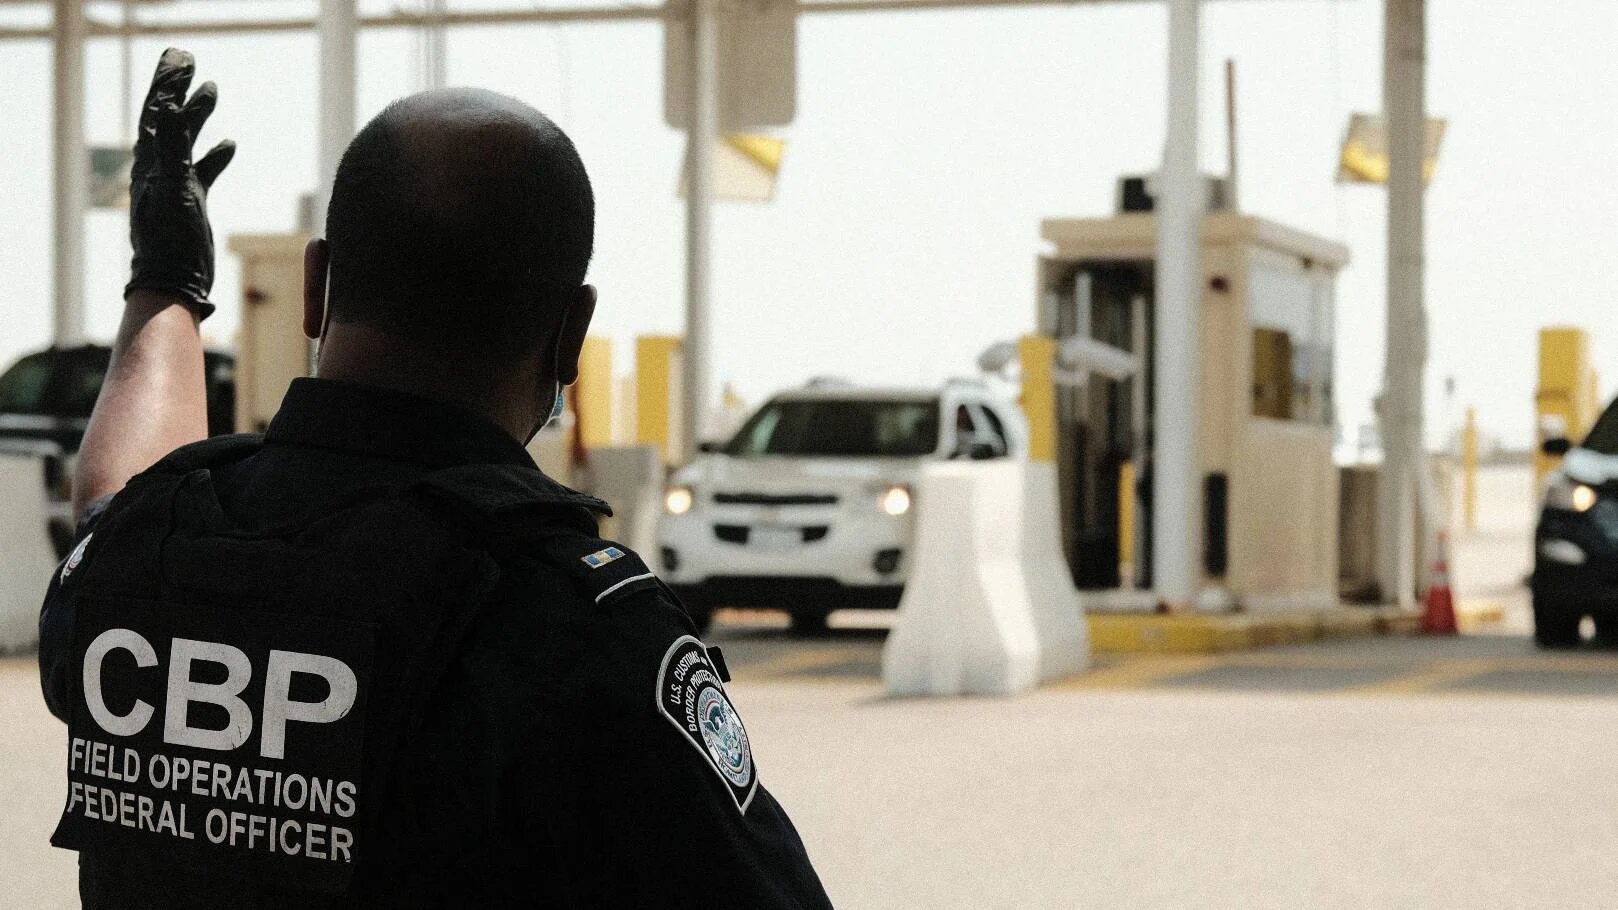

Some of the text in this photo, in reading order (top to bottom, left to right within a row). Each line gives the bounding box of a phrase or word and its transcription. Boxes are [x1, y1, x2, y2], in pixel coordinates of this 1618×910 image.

[83, 628, 357, 759] CBP
[671, 651, 700, 705] U.S. CUSTOMS
[686, 670, 723, 732] BORDER PROTEC
[71, 737, 357, 818] FIELD OPERATIONS
[67, 781, 354, 863] FEDERAL OFFICER
